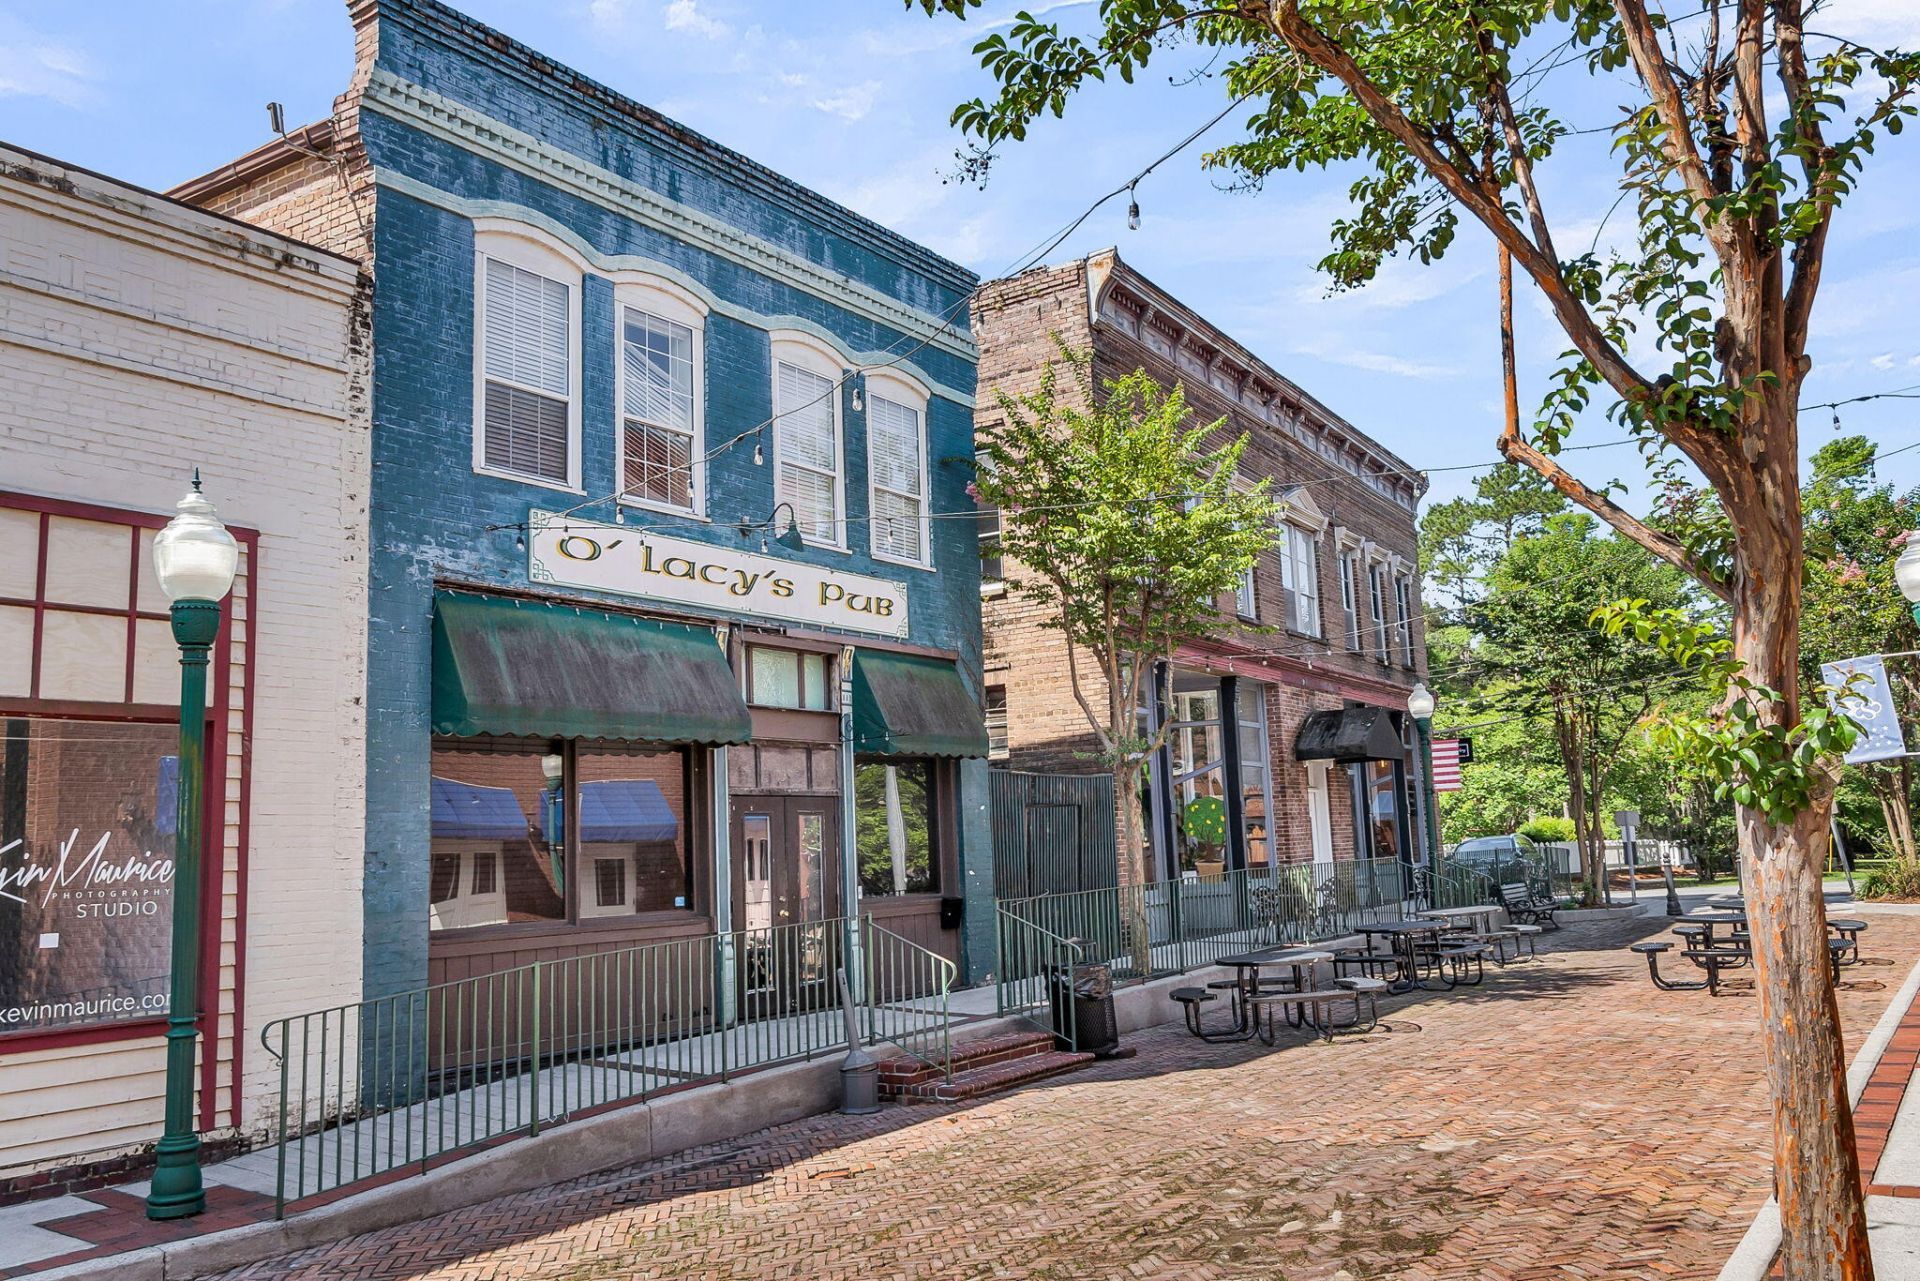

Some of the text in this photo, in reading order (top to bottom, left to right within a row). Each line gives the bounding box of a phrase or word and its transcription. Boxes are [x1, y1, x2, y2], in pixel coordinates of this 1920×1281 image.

[641, 545, 795, 598] Lacy's
[42, 828, 175, 908] Maurice
[52, 888, 171, 899] PHOTOGRAPHY
[77, 901, 157, 918] STUDIO
[0, 993, 171, 1023] kevinmaurice.co
